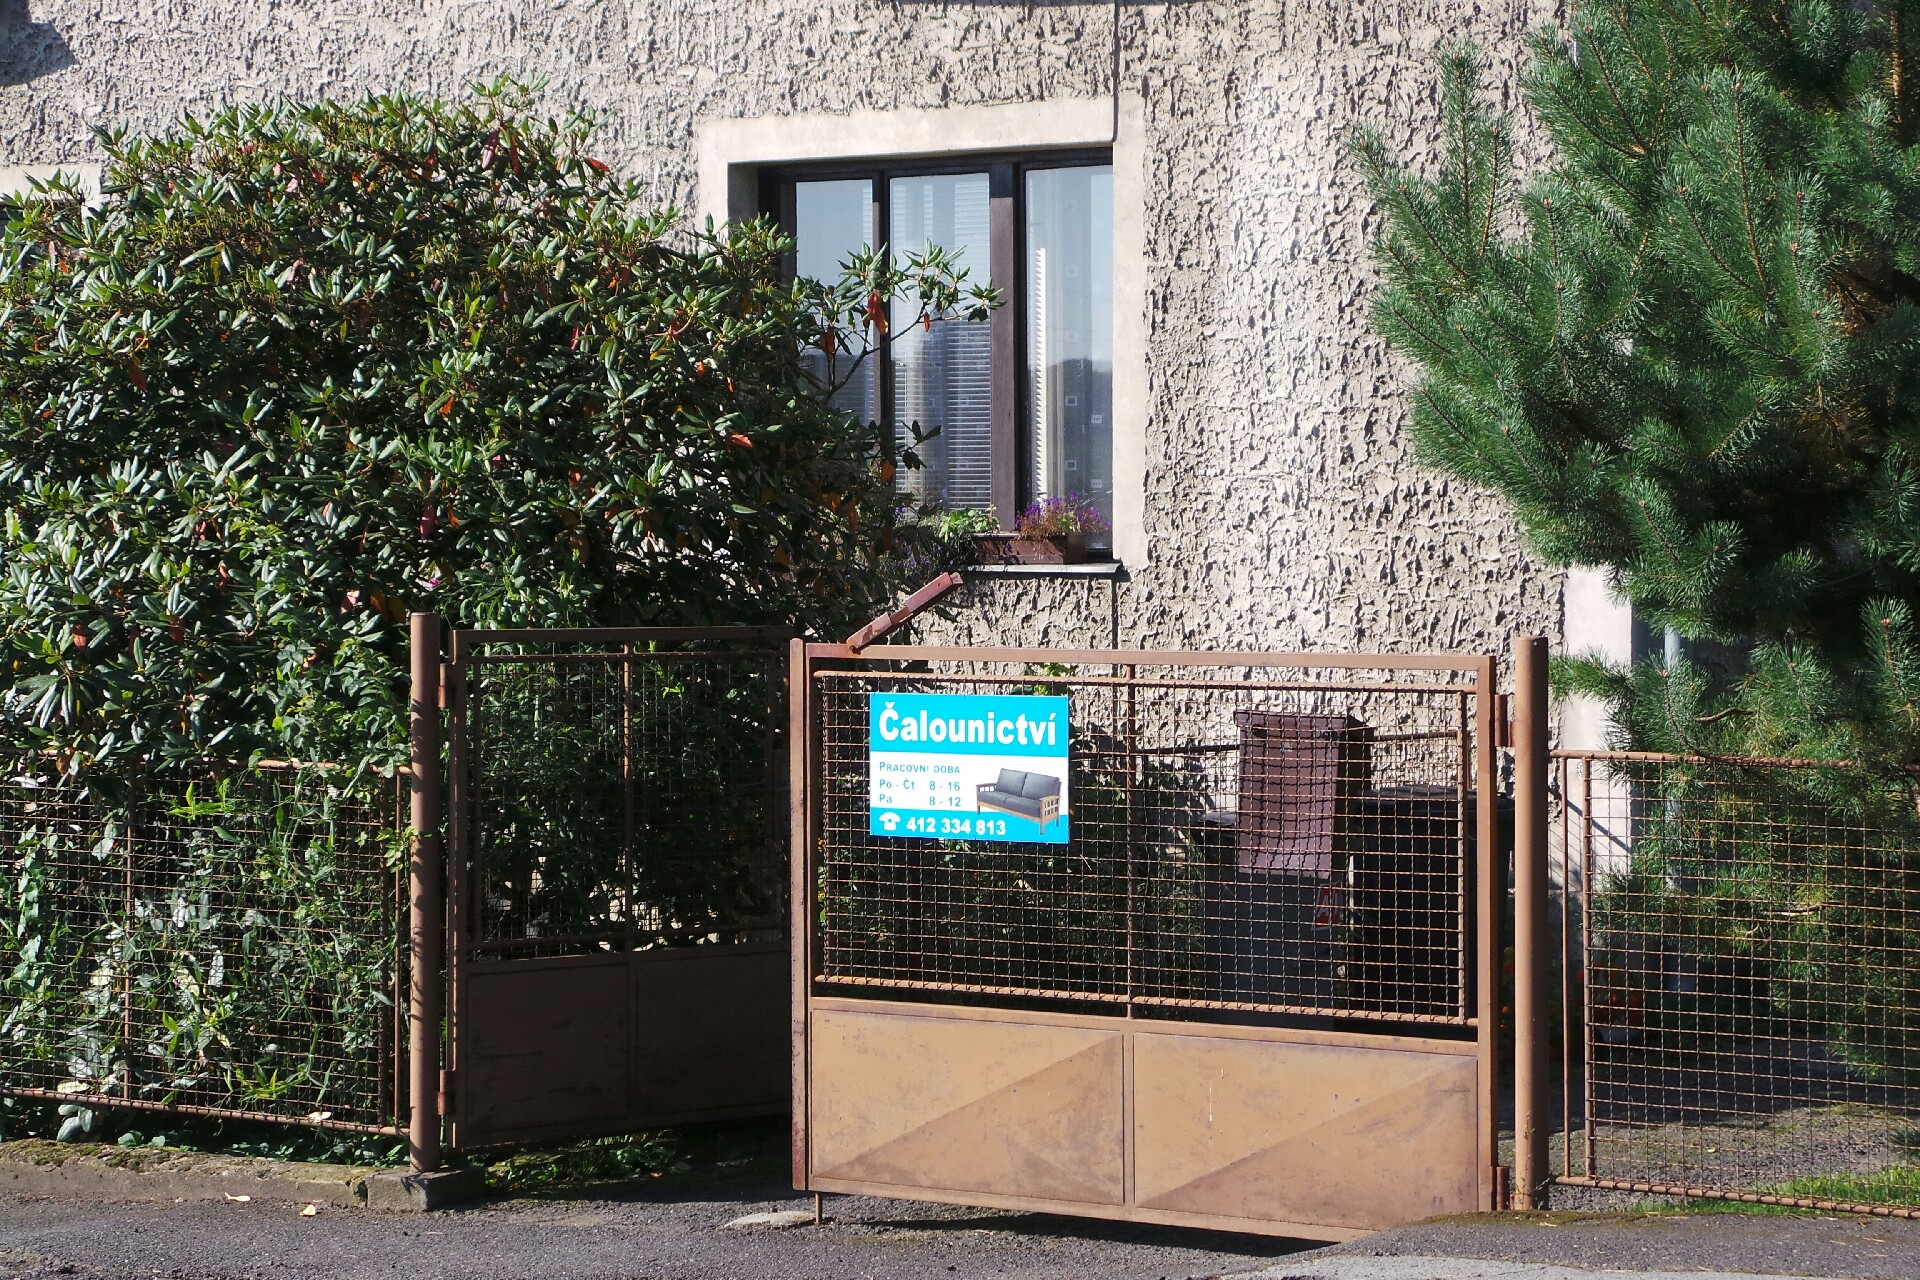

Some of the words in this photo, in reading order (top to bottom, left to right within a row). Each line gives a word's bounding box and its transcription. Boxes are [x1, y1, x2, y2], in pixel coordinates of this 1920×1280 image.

[878, 701, 1057, 746] Čalounictví
[933, 764, 961, 774] DOBA
[879, 778, 892, 789] Po
[903, 777, 916, 790] Čt
[929, 780, 936, 791] 8
[947, 781, 961, 792] 16
[929, 796, 936, 806] 8
[947, 796, 962, 807] 12
[906, 816, 936, 833] 412
[940, 818, 972, 834] 334
[975, 819, 1007, 836] 813
